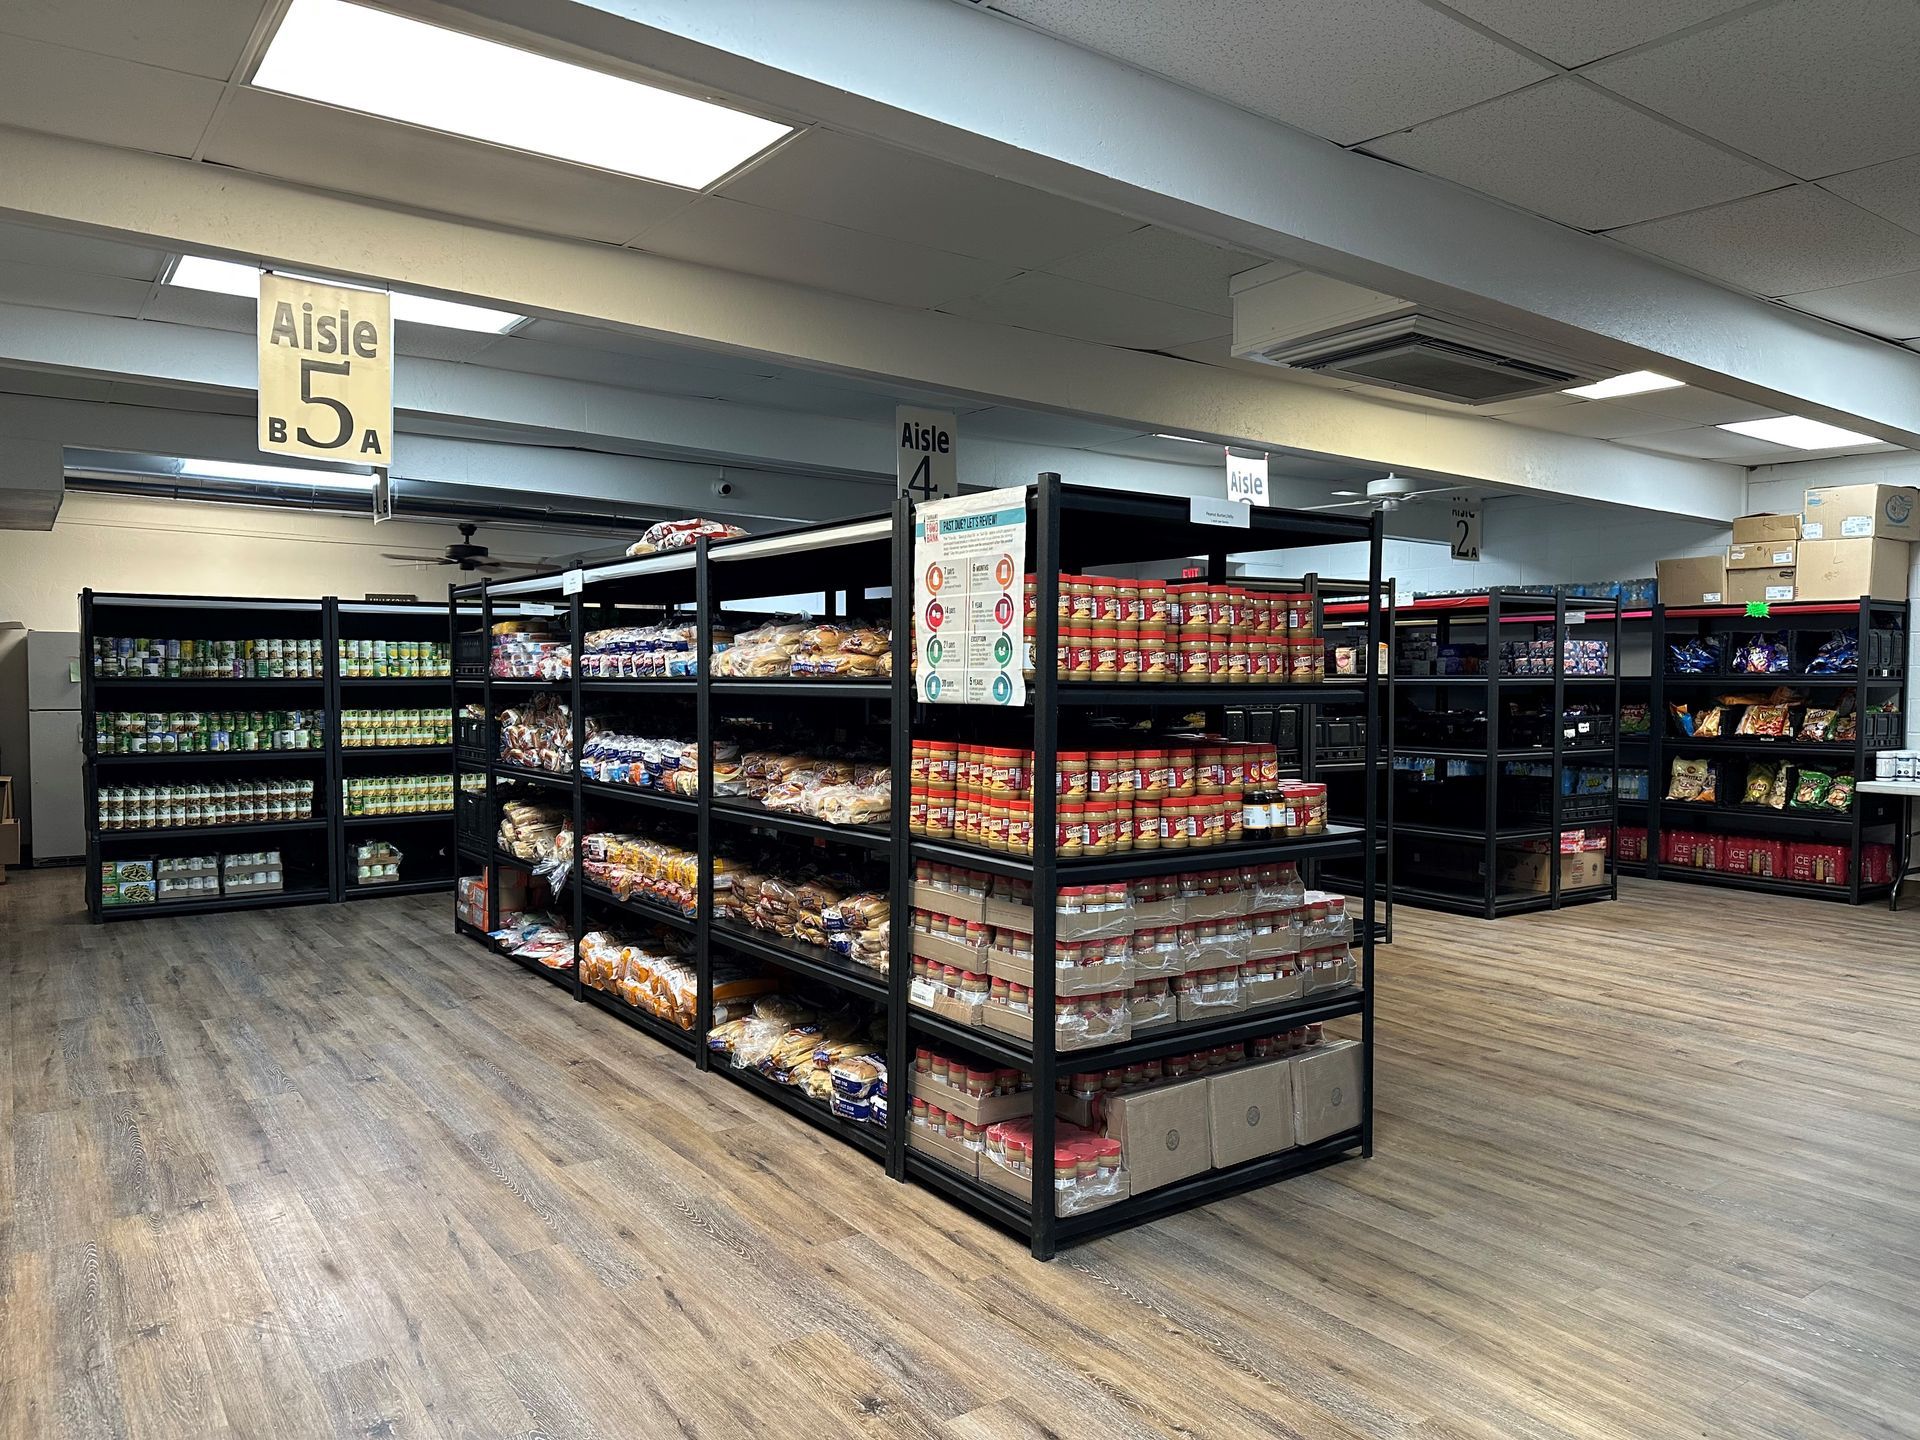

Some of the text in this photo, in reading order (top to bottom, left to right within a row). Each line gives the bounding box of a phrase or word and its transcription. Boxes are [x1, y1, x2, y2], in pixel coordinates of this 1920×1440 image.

[270, 301, 378, 359] Aisle
[297, 358, 354, 449] 5
[268, 416, 382, 455] B A
[901, 422, 950, 454] Aisle
[908, 455, 938, 501] 4
[1230, 471, 1263, 495] Aisle
[943, 514, 998, 532] PAST DUE? LET'S REVIEW!
[1456, 519, 1470, 557] 2
[1470, 547, 1478, 558] A
[972, 563, 976, 572] 6
[1182, 567, 1199, 578] EXIT
[1621, 838, 1634, 847] ICE
[1674, 844, 1689, 853] ICE
[1730, 850, 1745, 859] ICE
[1795, 856, 1809, 865] ICE
